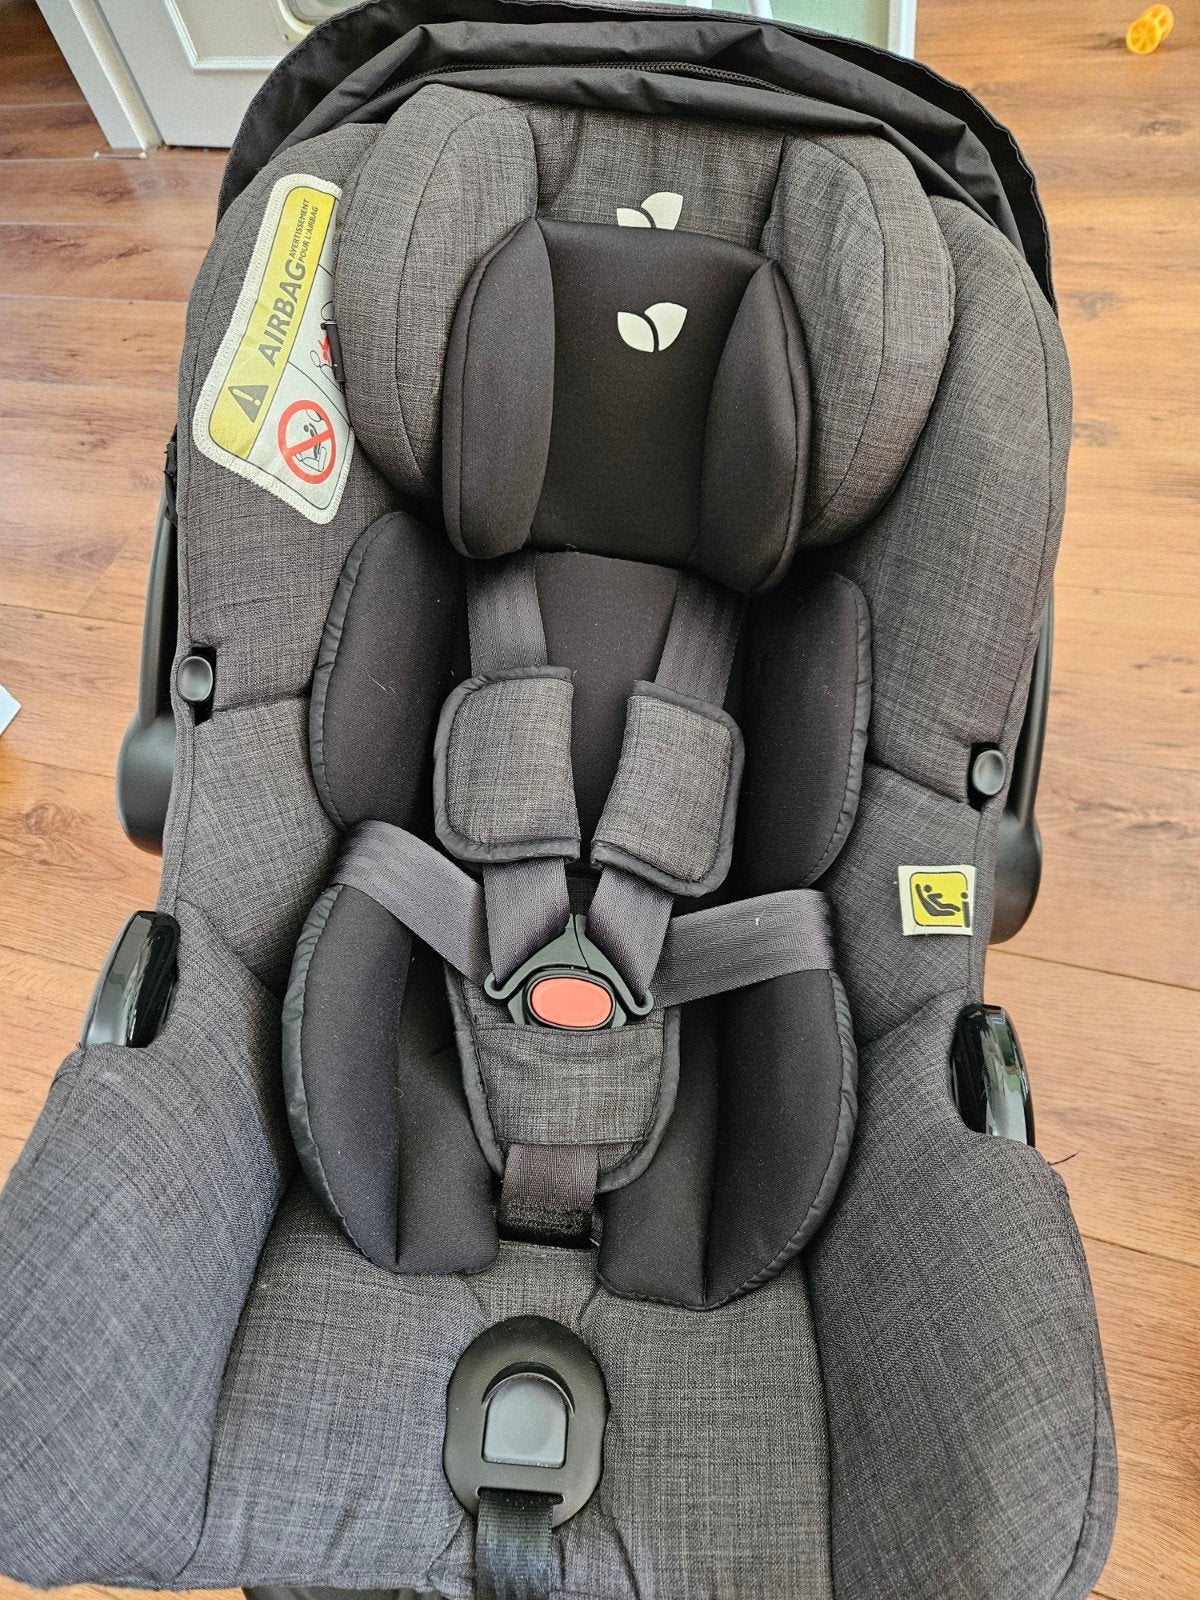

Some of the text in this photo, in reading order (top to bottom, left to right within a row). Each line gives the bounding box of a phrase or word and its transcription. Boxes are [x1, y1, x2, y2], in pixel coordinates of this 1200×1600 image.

[289, 198, 309, 258] AVERTISSEMENT
[298, 206, 319, 263] POUR L'AIRBAG
[258, 259, 306, 367] AIRBAG
